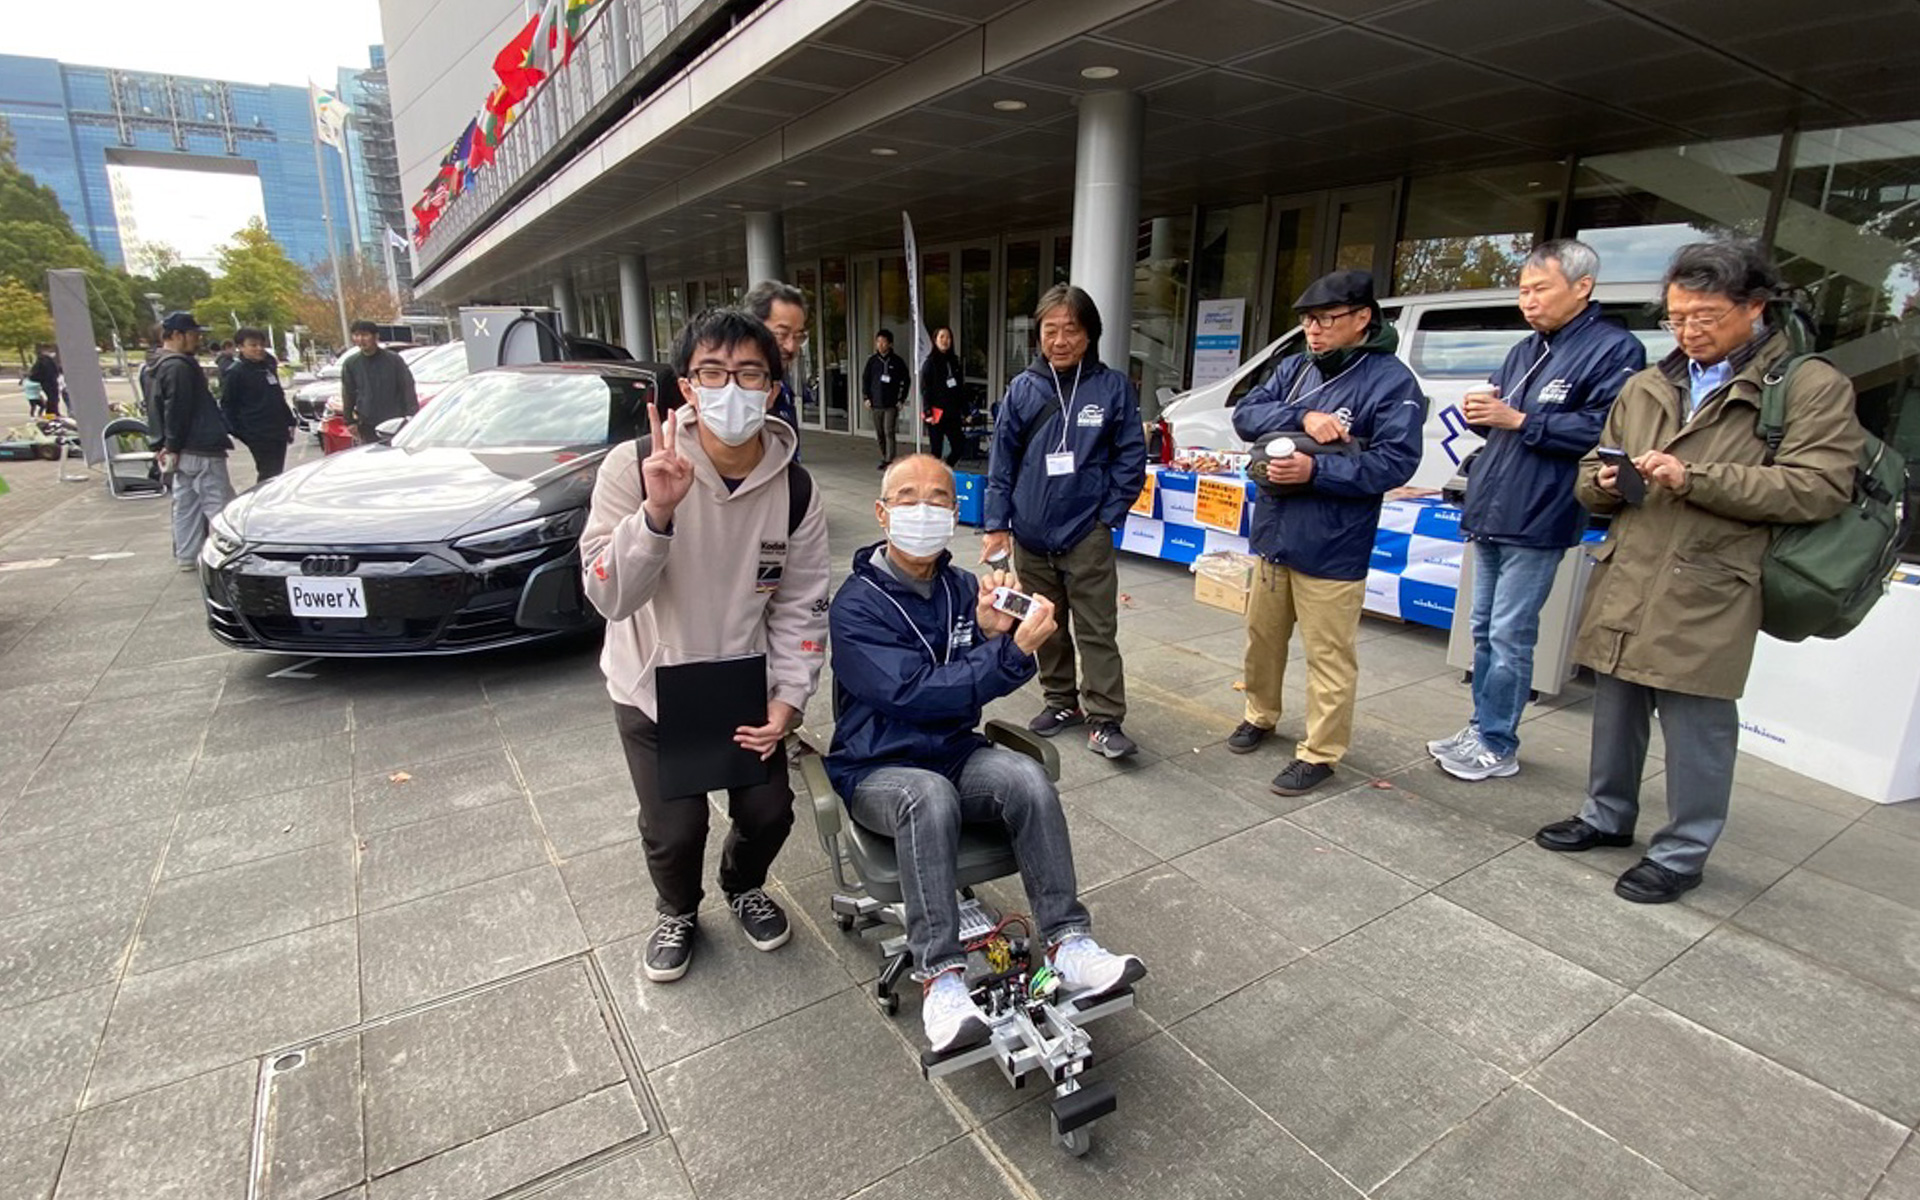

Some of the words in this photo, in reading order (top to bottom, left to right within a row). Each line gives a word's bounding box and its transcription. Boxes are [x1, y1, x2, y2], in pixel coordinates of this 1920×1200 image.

[1434, 510, 1462, 521] nichi
[761, 541, 786, 550] Kodak
[293, 586, 343, 608] Power
[346, 587, 360, 608] X
[1413, 598, 1455, 613] nichicon
